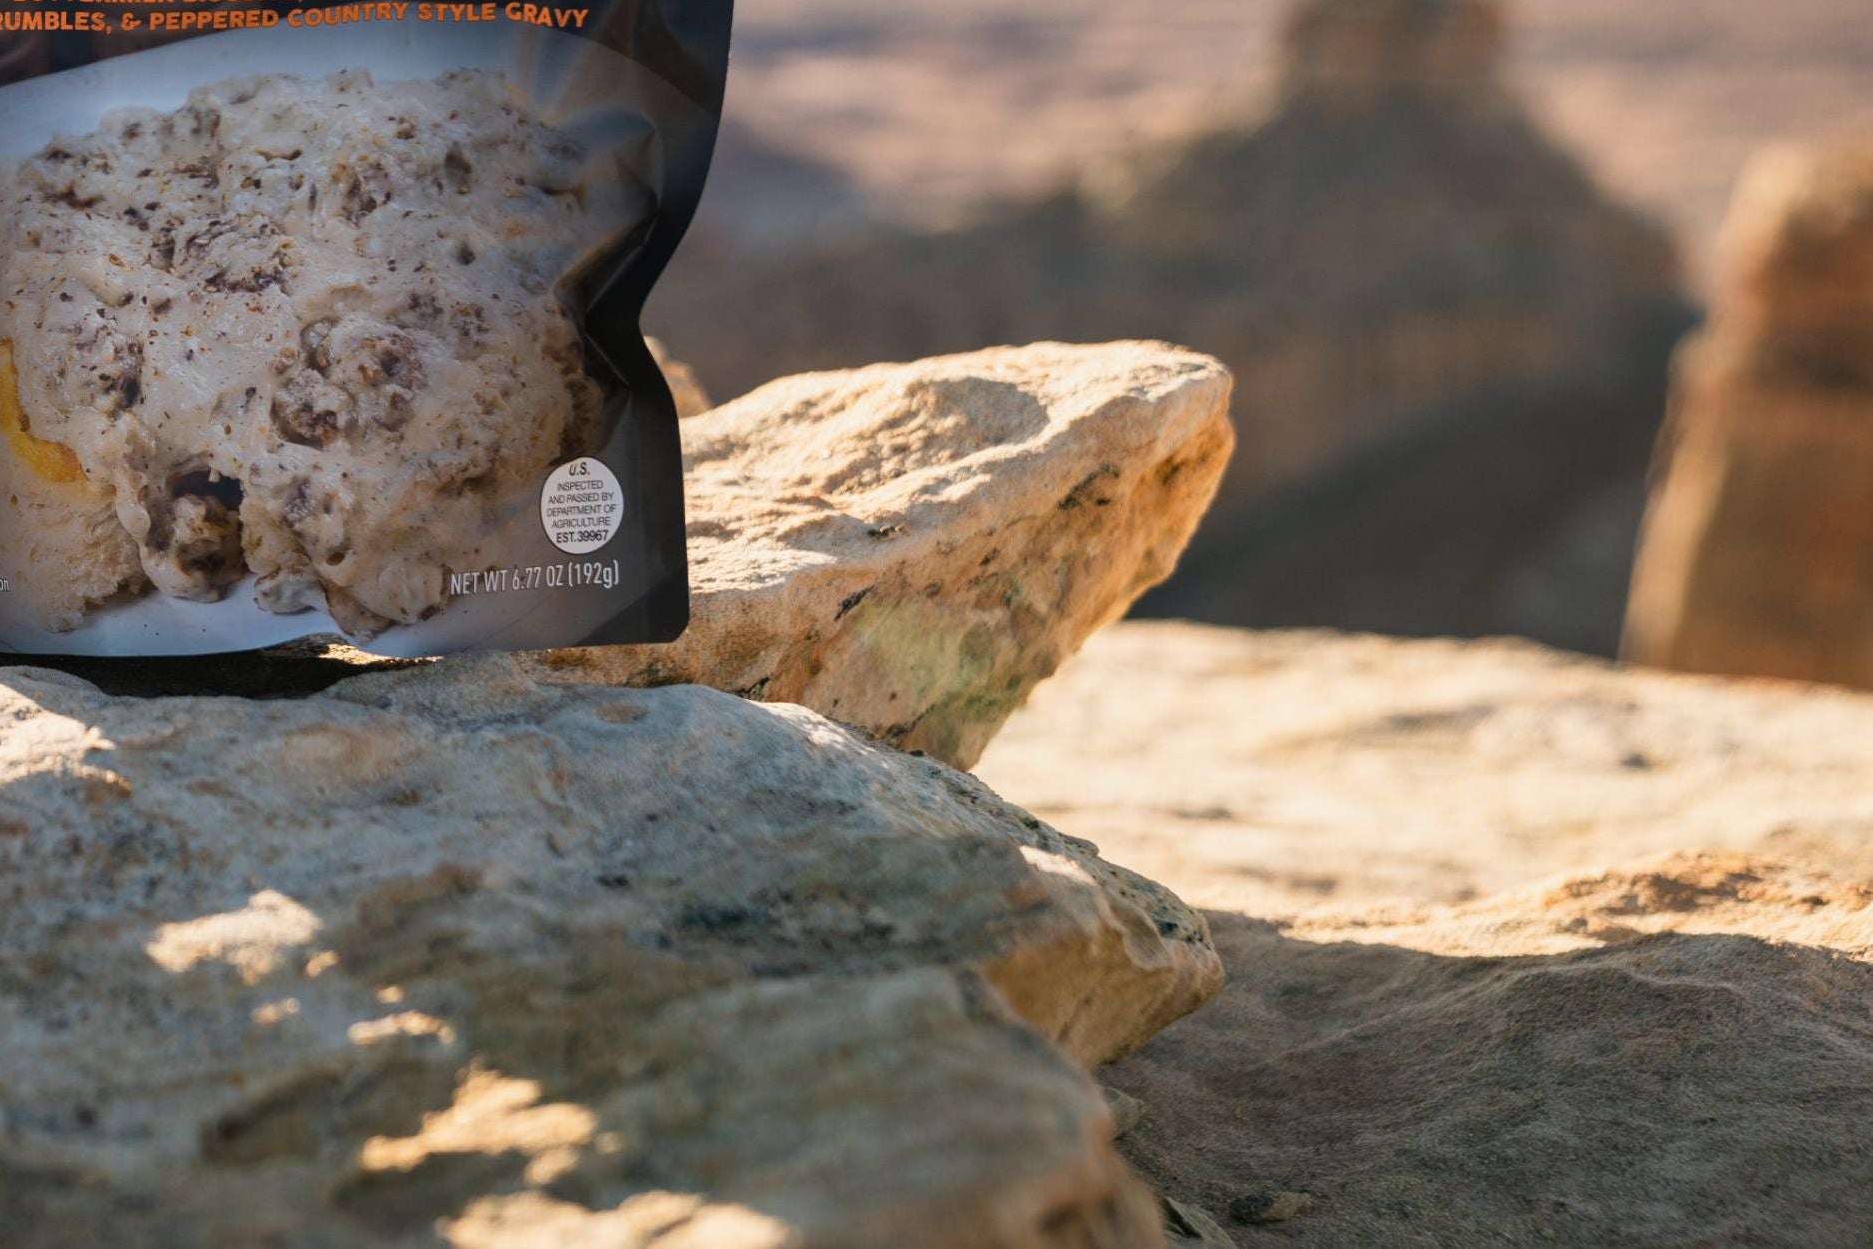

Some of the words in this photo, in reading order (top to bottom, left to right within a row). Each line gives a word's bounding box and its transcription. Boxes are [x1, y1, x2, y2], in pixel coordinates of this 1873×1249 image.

[121, 11, 141, 31] &
[149, 9, 279, 31] PEPPERED
[287, 1, 409, 28] COUNTRY
[417, 1, 497, 23] STYLE
[504, 1, 589, 28] GRAVY
[568, 461, 590, 476] U.S.
[557, 479, 604, 492] INSPECTED
[548, 495, 566, 504] AND
[566, 493, 600, 504] PASSED
[601, 492, 614, 501] BY
[546, 505, 602, 517] DEPARTMENT
[603, 504, 617, 514] OF
[551, 516, 612, 529] AGRICULTURE
[450, 572, 480, 595] NET
[483, 569, 508, 592] WT
[512, 566, 541, 591] 6.77
[545, 564, 563, 587] OZ
[568, 559, 619, 589] (192g)
